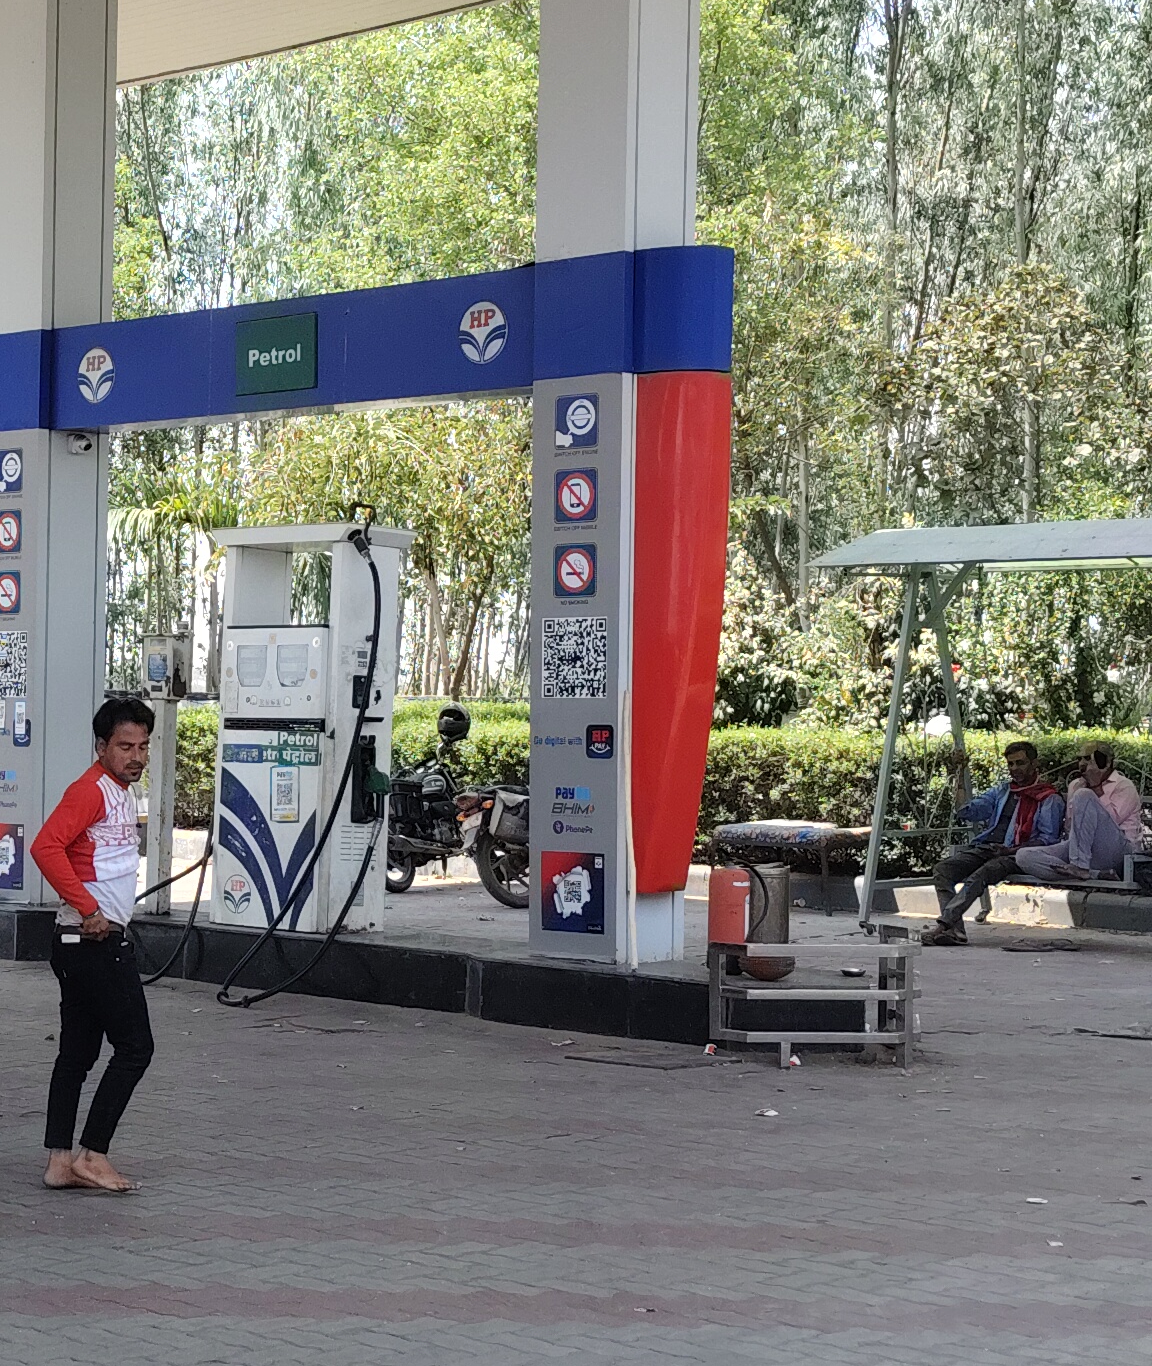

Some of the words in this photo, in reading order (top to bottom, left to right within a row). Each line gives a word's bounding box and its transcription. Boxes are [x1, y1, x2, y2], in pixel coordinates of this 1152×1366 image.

[468, 308, 496, 330] HP
[85, 354, 107, 373] HP
[248, 344, 302, 368] Petrol
[279, 731, 318, 747] Petrol
[591, 730, 610, 742] HP
[282, 747, 318, 764] पेट्रोल
[551, 802, 590, 815] BHIM
[230, 879, 246, 892] HP
